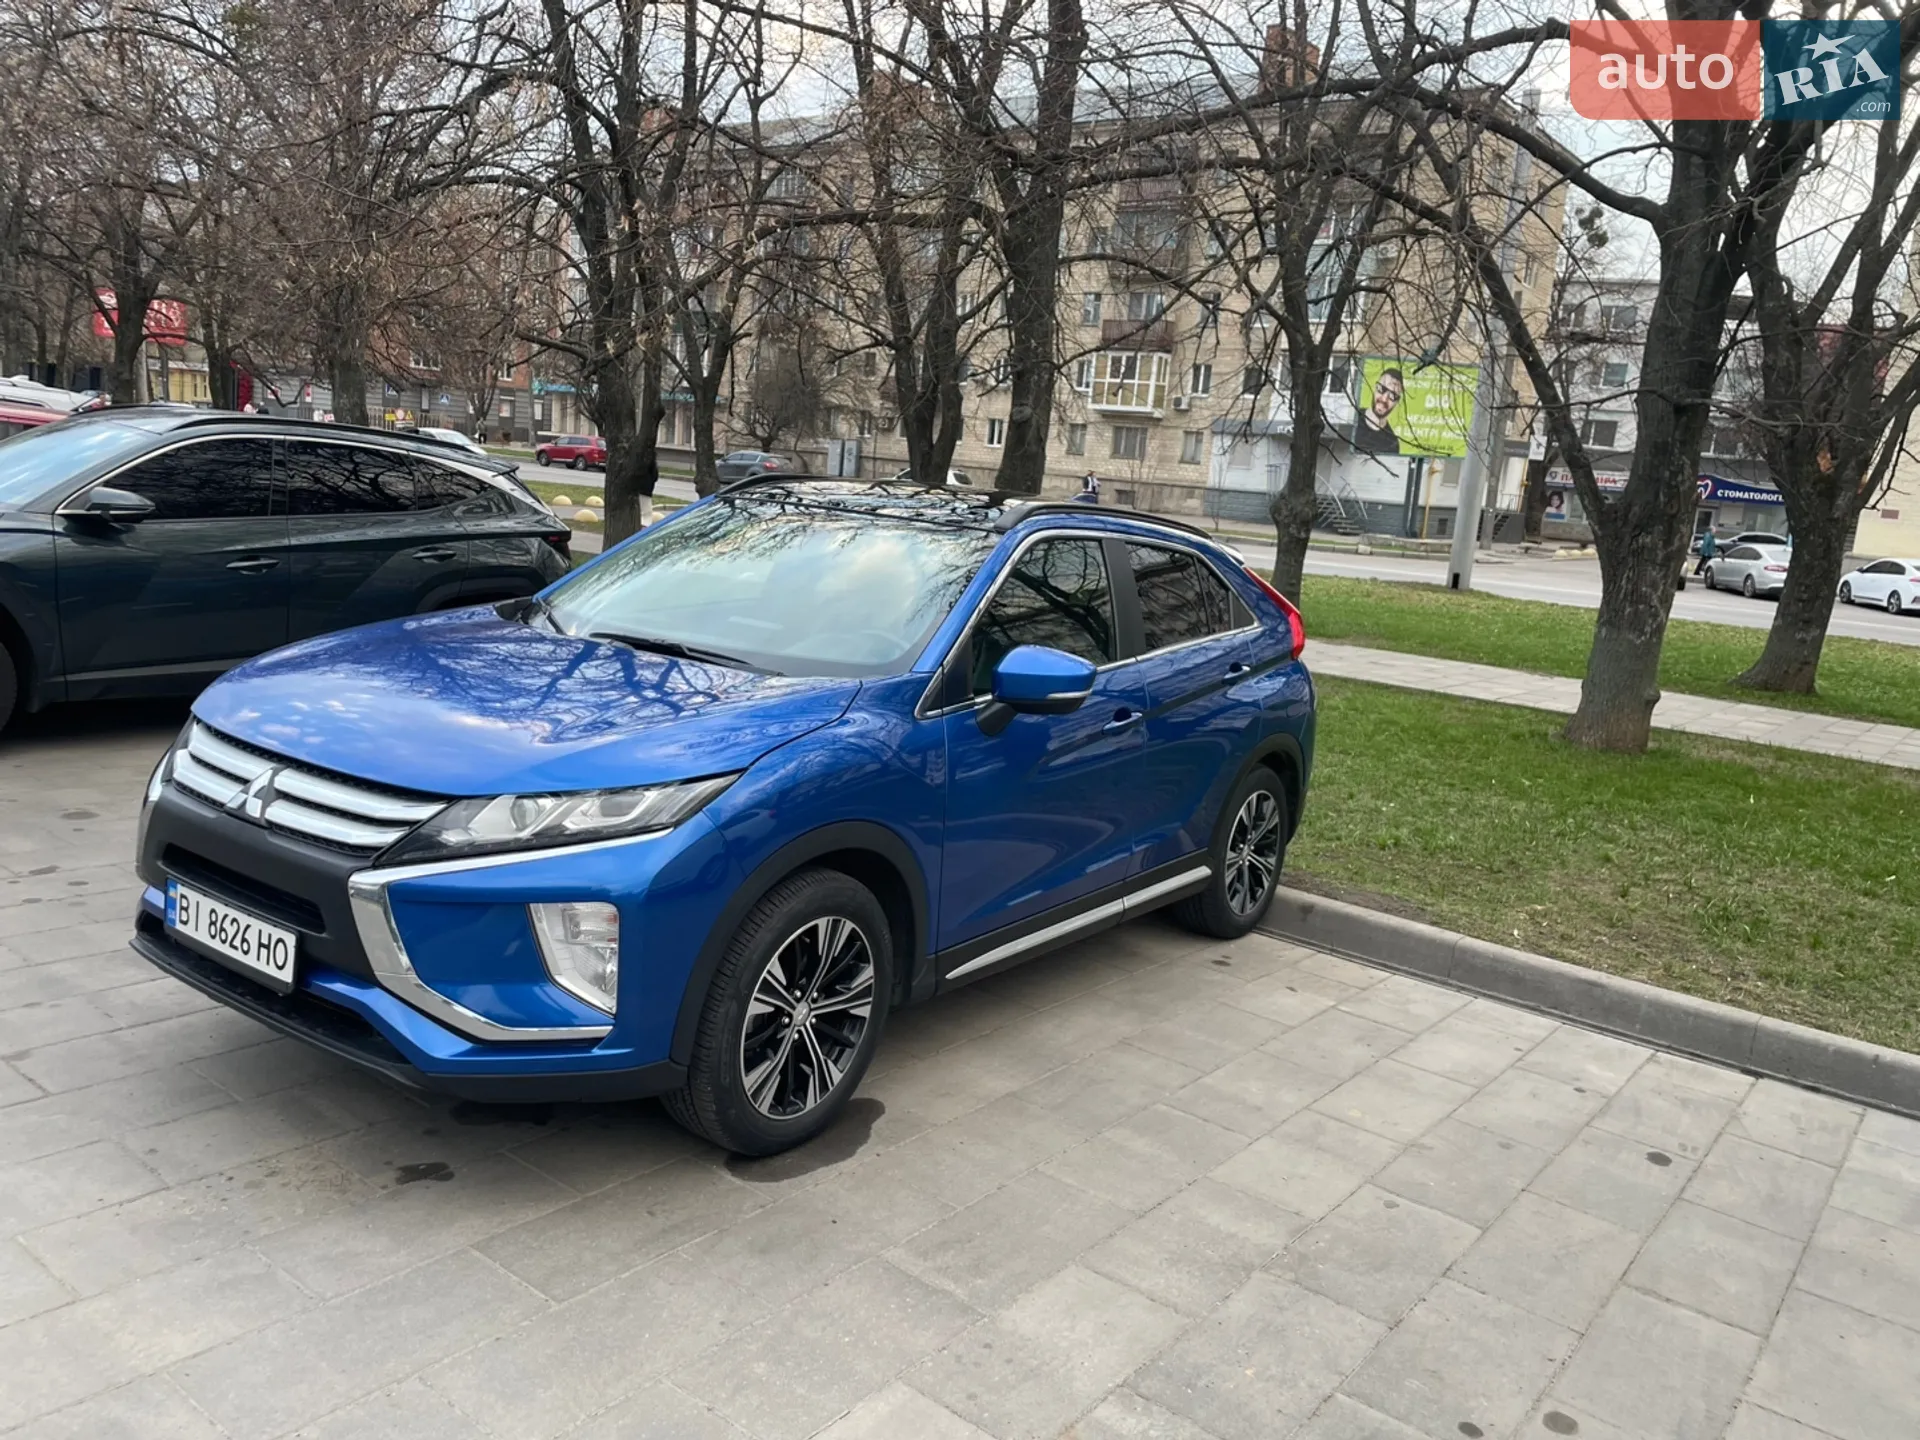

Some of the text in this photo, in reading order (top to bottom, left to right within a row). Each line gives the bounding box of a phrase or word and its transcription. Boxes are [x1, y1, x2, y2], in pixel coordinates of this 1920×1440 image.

[1717, 489, 1784, 502] СТОМАТОЛОГІ
[178, 893, 288, 971] BI 8626 HO
